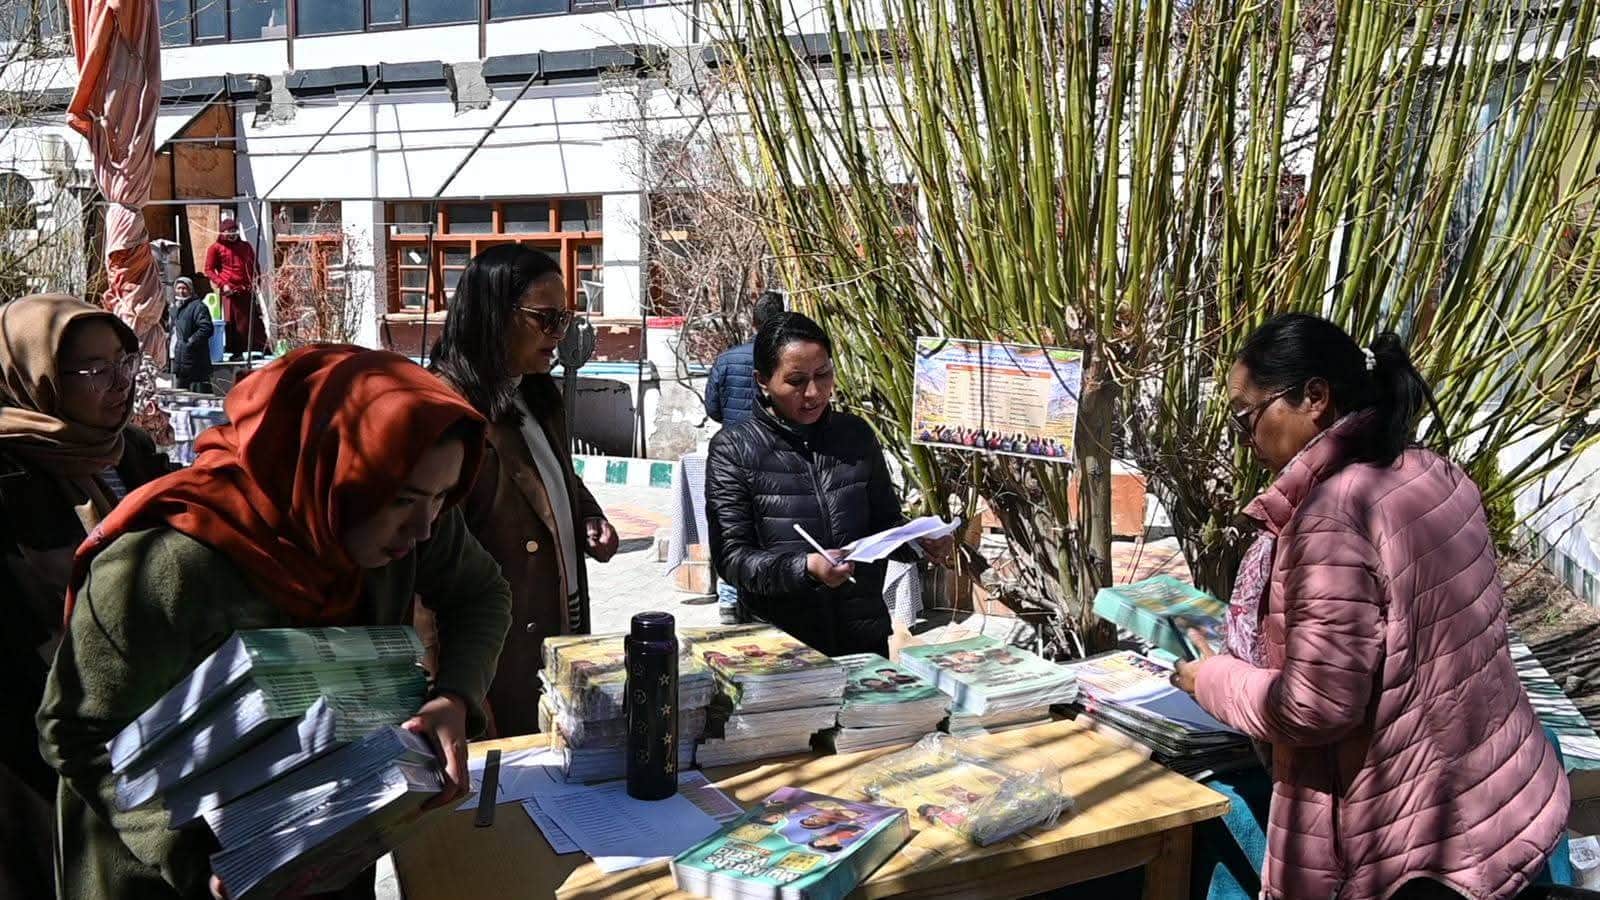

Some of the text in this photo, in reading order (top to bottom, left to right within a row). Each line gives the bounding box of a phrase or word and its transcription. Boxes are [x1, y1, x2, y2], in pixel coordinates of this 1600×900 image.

[703, 855, 801, 882] My Maths
[712, 846, 769, 867] World
